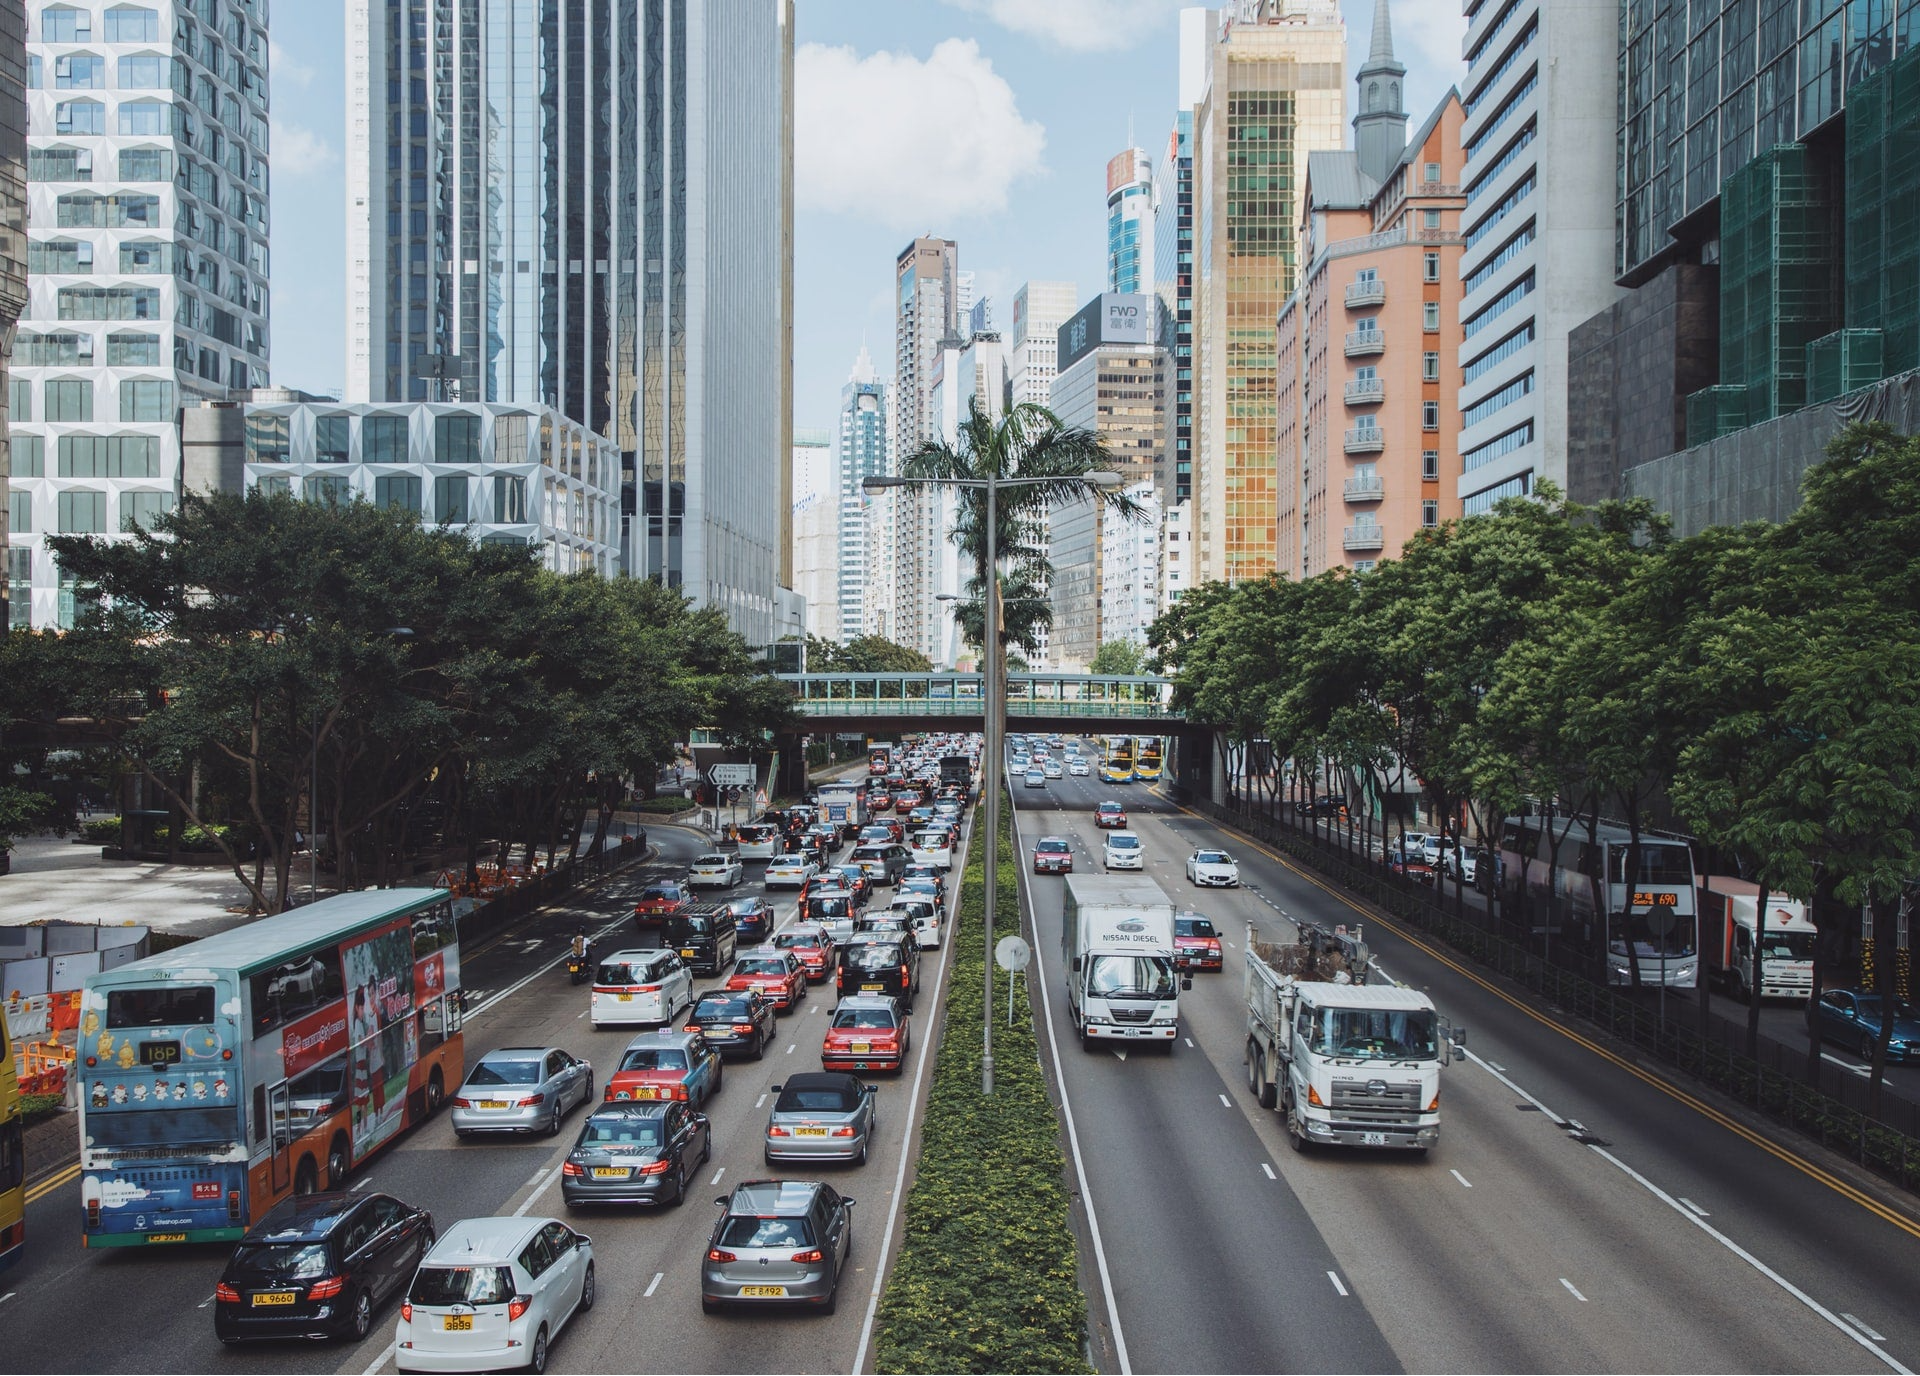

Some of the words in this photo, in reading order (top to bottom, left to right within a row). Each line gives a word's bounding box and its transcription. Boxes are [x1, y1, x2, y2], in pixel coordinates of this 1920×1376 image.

[1110, 305, 1138, 317] FWD
[1659, 894, 1676, 905] 690
[1132, 934, 1160, 943] DIESEL
[148, 1046, 176, 1060] 18P
[195, 1184, 218, 1193] 周大福
[744, 1287, 756, 1295] FE
[255, 1295, 267, 1304] UL
[269, 1294, 293, 1303] 9660
[446, 1321, 471, 1331] 3899
